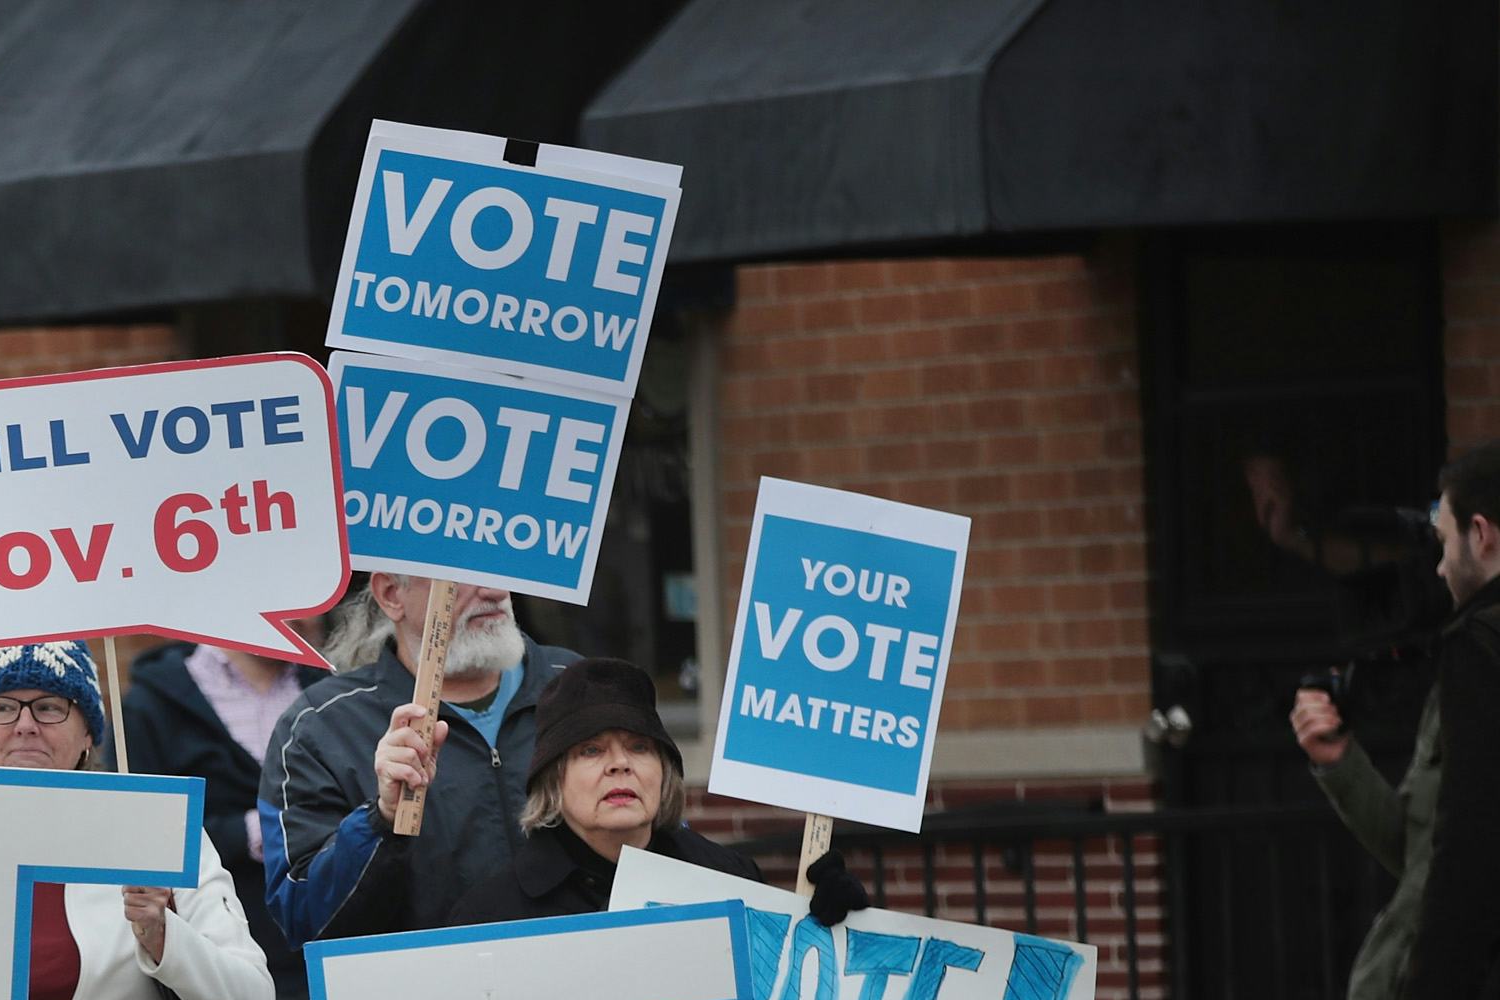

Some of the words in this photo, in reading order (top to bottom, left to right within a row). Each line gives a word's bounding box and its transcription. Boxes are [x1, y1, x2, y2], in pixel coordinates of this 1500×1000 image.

[382, 170, 655, 295] VOTE
[355, 271, 637, 351] TOMORROW
[110, 395, 305, 459] VOTE
[345, 386, 605, 503] VOTE
[154, 480, 297, 573] 6th
[343, 490, 589, 558] OMORROW
[801, 558, 910, 608] YOUR
[755, 602, 938, 689] VOTE
[740, 685, 920, 748] MATTERS
